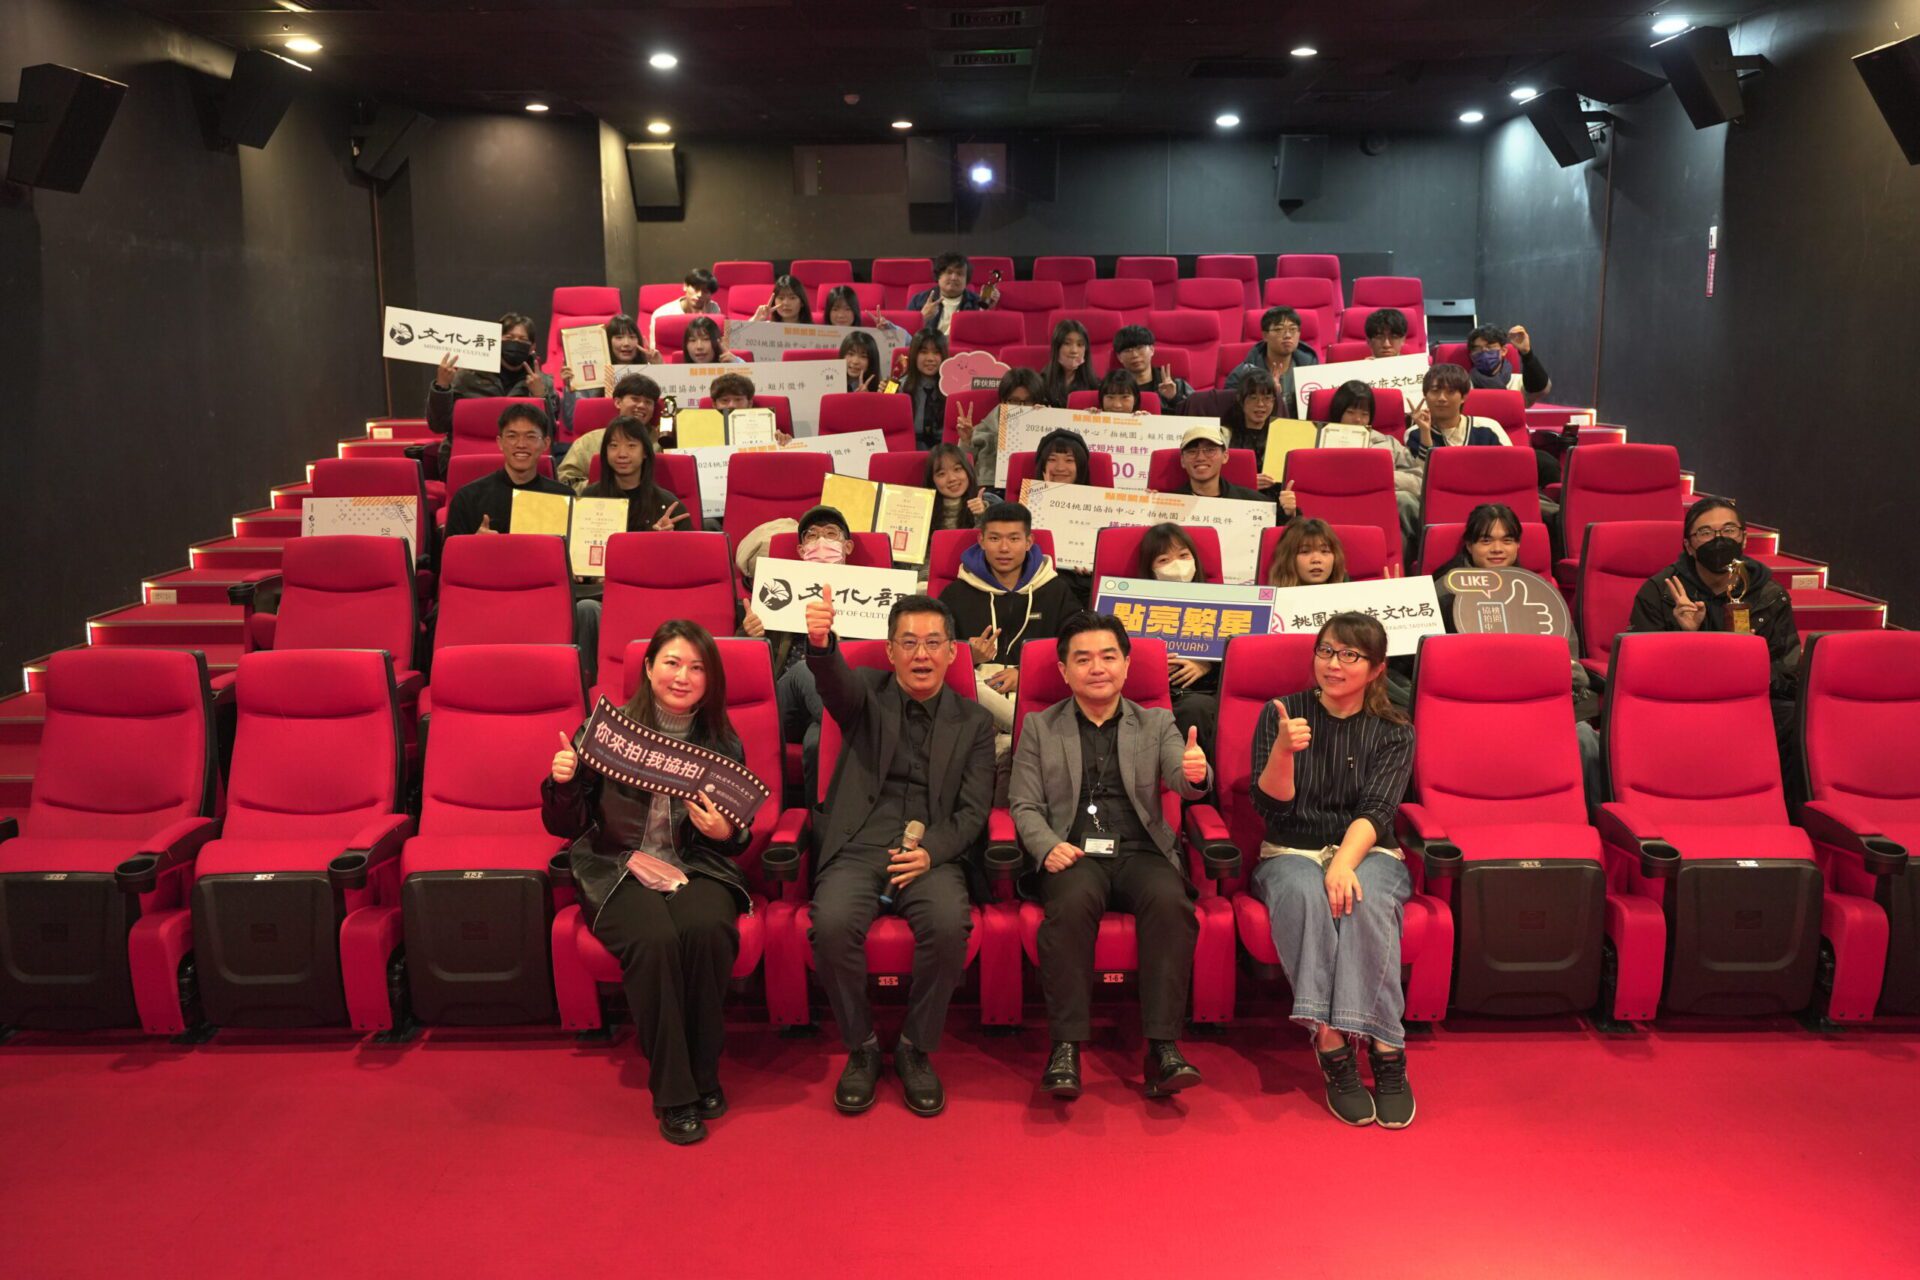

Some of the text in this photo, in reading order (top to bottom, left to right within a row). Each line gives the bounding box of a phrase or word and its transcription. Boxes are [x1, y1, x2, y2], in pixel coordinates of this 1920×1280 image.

[418, 328, 497, 351] 文化部
[1460, 575, 1490, 587] LIKE
[1112, 602, 1253, 640] 點亮繁星
